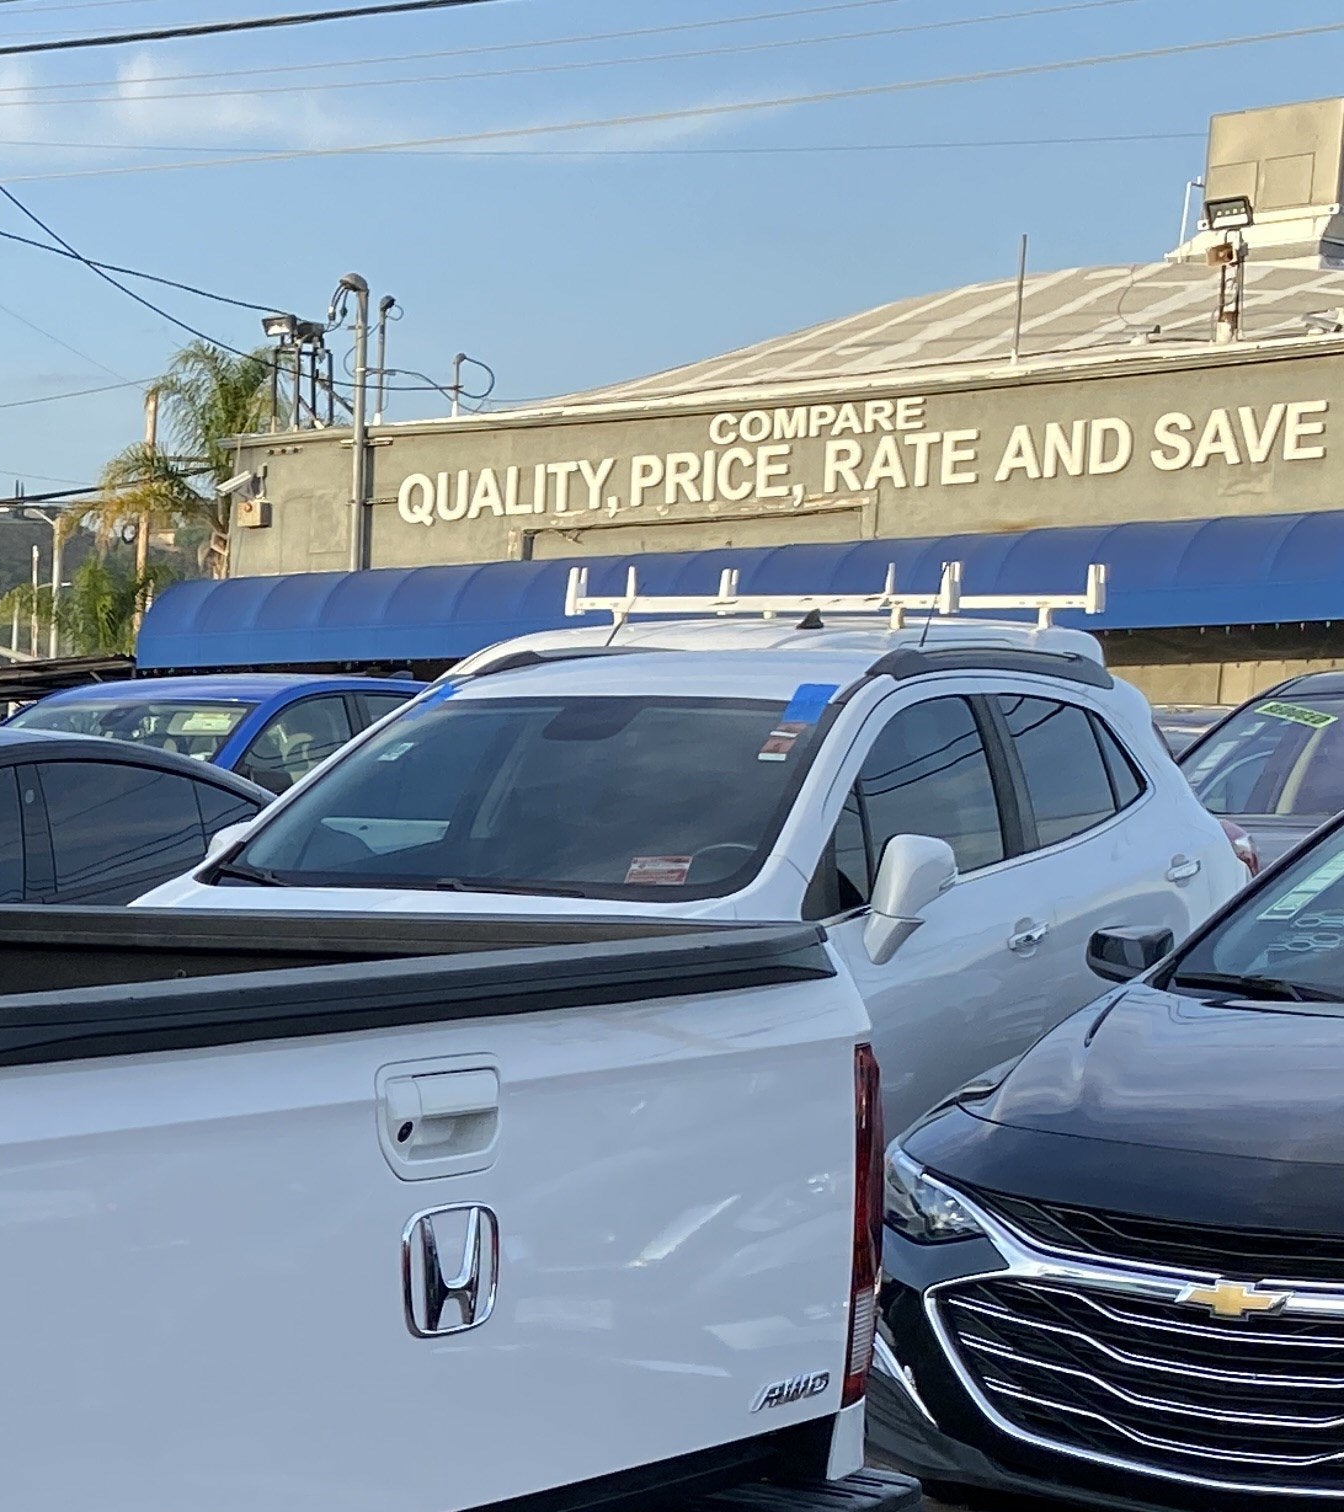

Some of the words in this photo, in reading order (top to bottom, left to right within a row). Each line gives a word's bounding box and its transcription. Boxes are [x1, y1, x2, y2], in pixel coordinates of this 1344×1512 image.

[709, 396, 927, 446] COMPARE
[396, 456, 615, 527] QUALITY,
[628, 443, 807, 508] PRICE,
[823, 428, 980, 493] RATE
[994, 416, 1134, 483] AND
[1150, 399, 1329, 471] SAVE
[750, 1369, 830, 1413] AWD
